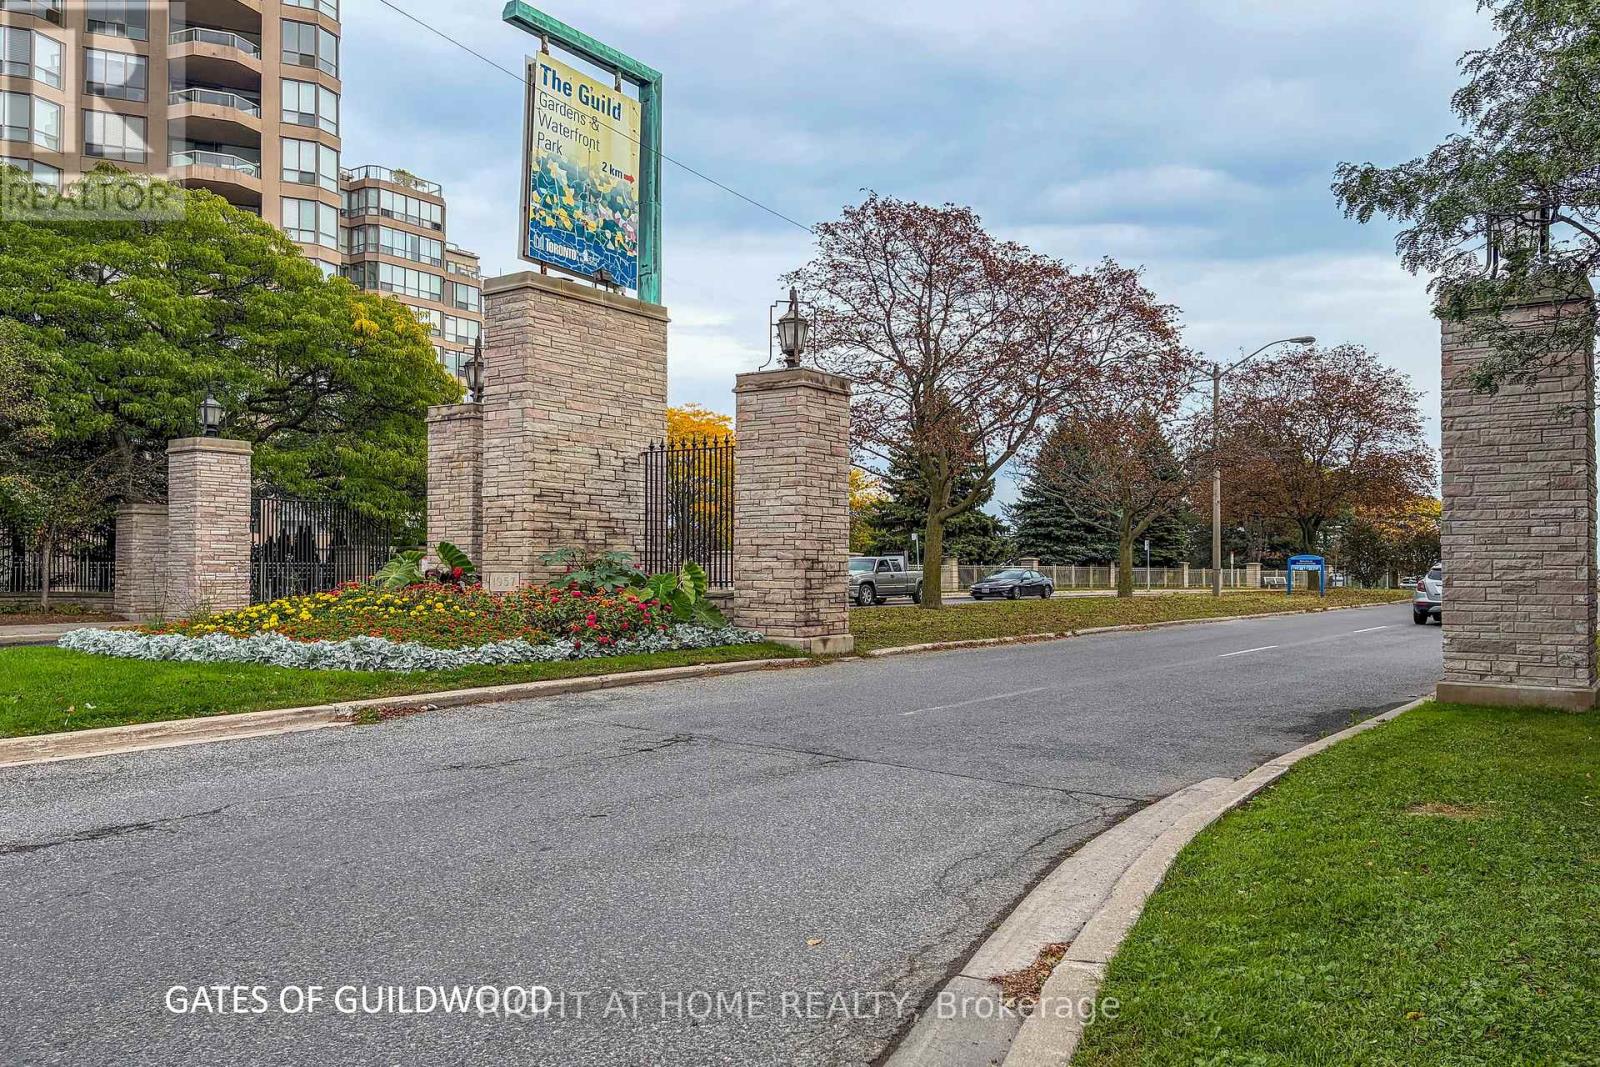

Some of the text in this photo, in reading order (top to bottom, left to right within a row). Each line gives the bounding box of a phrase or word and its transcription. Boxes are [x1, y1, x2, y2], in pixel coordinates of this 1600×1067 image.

[539, 92, 599, 132] Gardens &
[540, 64, 621, 121] The Guild
[537, 131, 562, 155] Park
[538, 110, 600, 152] Waterfront
[601, 161, 623, 179] 2 km
